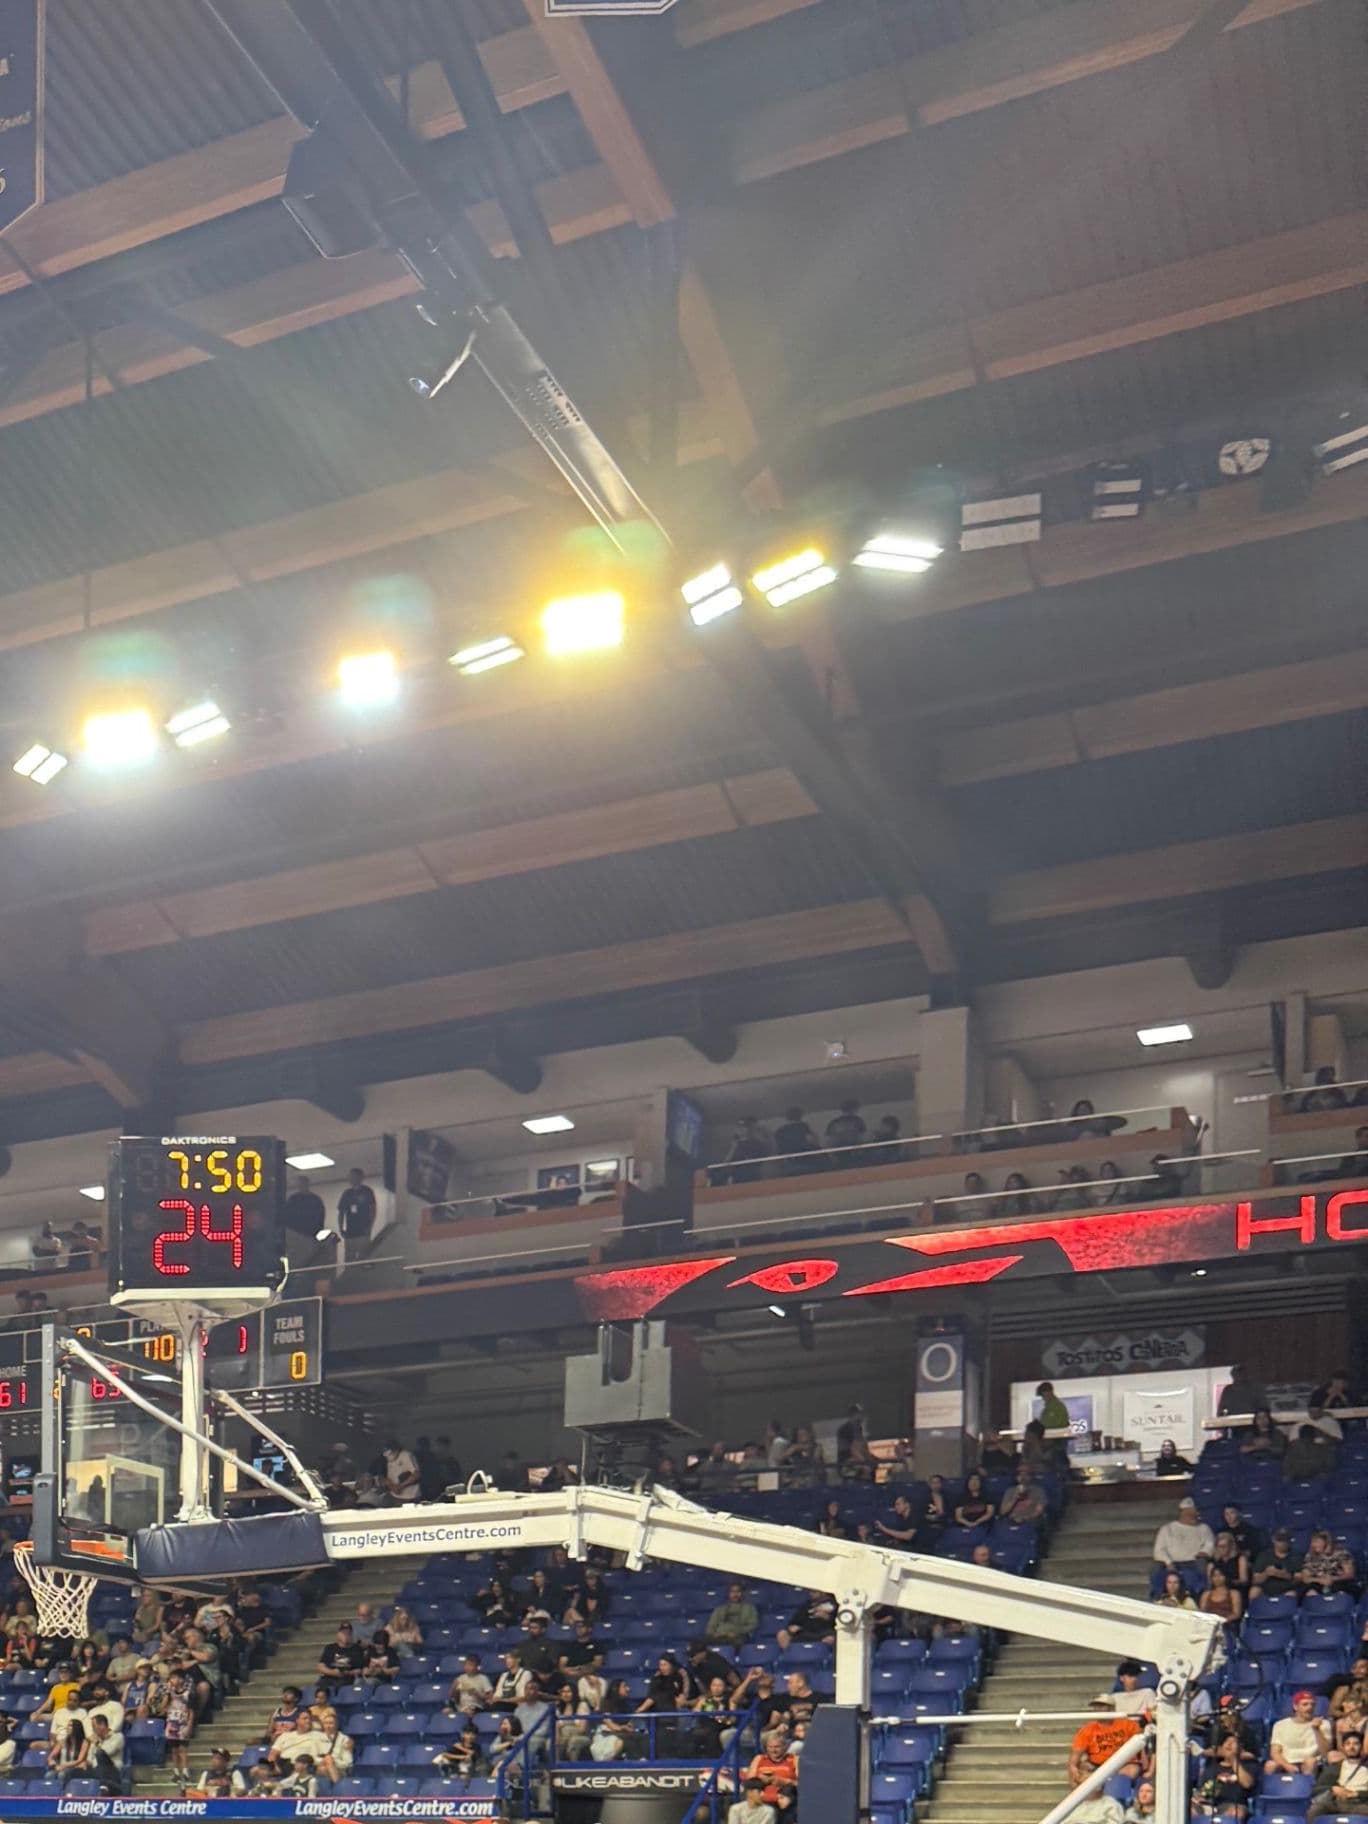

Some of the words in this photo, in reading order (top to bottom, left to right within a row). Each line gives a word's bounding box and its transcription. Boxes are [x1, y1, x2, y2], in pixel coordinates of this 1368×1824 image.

[161, 1136, 237, 1146] DAKTRONICS
[168, 1150, 262, 1193] 7:50
[152, 1200, 243, 1275] 24
[275, 1315, 304, 1330] TEAM
[273, 1329, 305, 1345] FOULS
[290, 1351, 307, 1380] 0
[331, 1525, 522, 1548] LangleyEventsCentre.com
[56, 1799, 111, 1816] Langley
[112, 1799, 157, 1815] Events
[160, 1799, 207, 1815] Centre
[296, 1799, 493, 1819] LangleyEventsCentre.com
